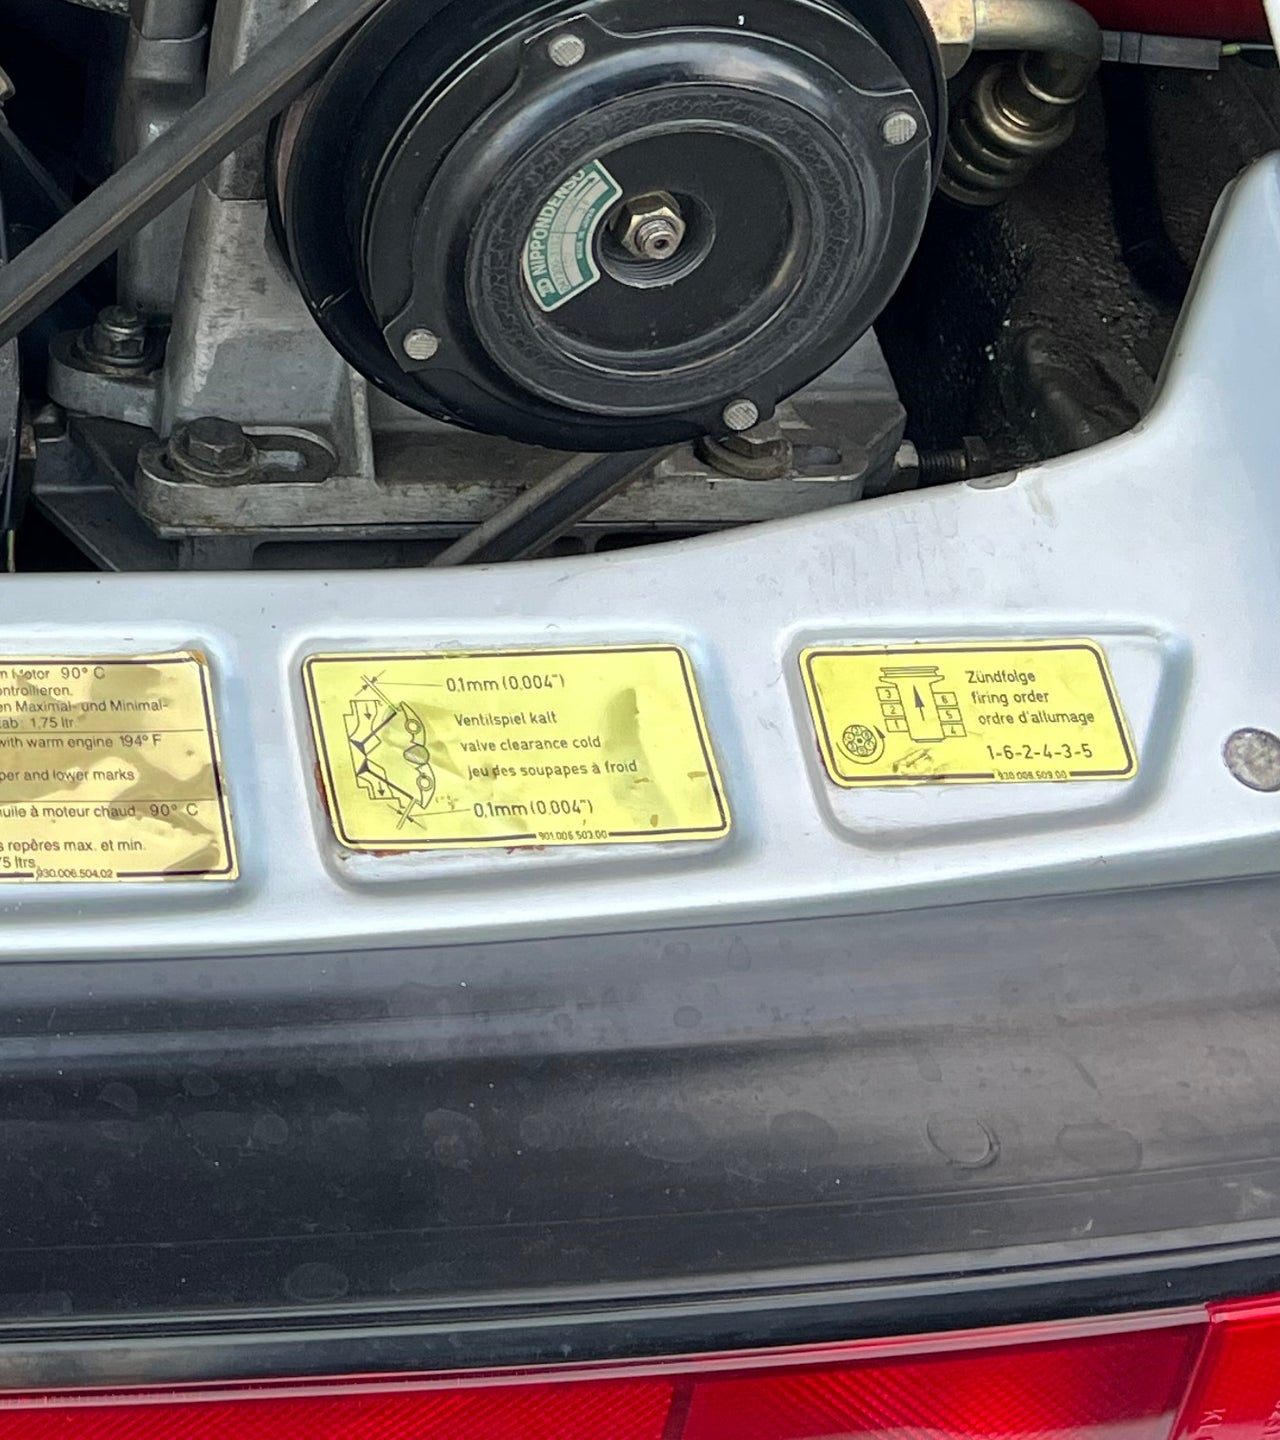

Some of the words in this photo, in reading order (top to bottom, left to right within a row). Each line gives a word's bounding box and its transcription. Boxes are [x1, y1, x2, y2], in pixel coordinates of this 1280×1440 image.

[60, 666, 88, 680] 90°
[94, 666, 106, 679] C
[965, 668, 1036, 686] Zündfolge
[15, 700, 78, 712] Maximal-
[81, 700, 107, 711] und
[110, 699, 169, 711] Minimal-
[971, 690, 1009, 707] firing
[1013, 690, 1050, 703] order
[889, 705, 897, 714] 2
[978, 711, 1015, 725] ordre
[1018, 709, 1095, 726] d'allumage
[454, 712, 527, 728] Ventilspiel
[530, 710, 558, 724] kalt
[26, 738, 64, 748] warm
[67, 736, 113, 751] engine
[152, 733, 162, 746] F
[460, 738, 497, 752] valve
[500, 738, 569, 751] clearance
[572, 735, 602, 748] cold
[23, 769, 49, 780] and
[52, 769, 90, 781] lower
[92, 768, 135, 781] marks
[467, 764, 490, 781] jeu
[520, 763, 588, 779] soupapes
[592, 762, 601, 775] à
[604, 759, 638, 773] froid
[30, 804, 40, 817] à
[42, 806, 90, 817] moteur
[150, 803, 178, 817] 90°
[186, 802, 199, 816] C
[7, 838, 61, 854] repères
[63, 840, 97, 852] max.
[100, 840, 114, 851] et
[117, 839, 146, 851] min.
